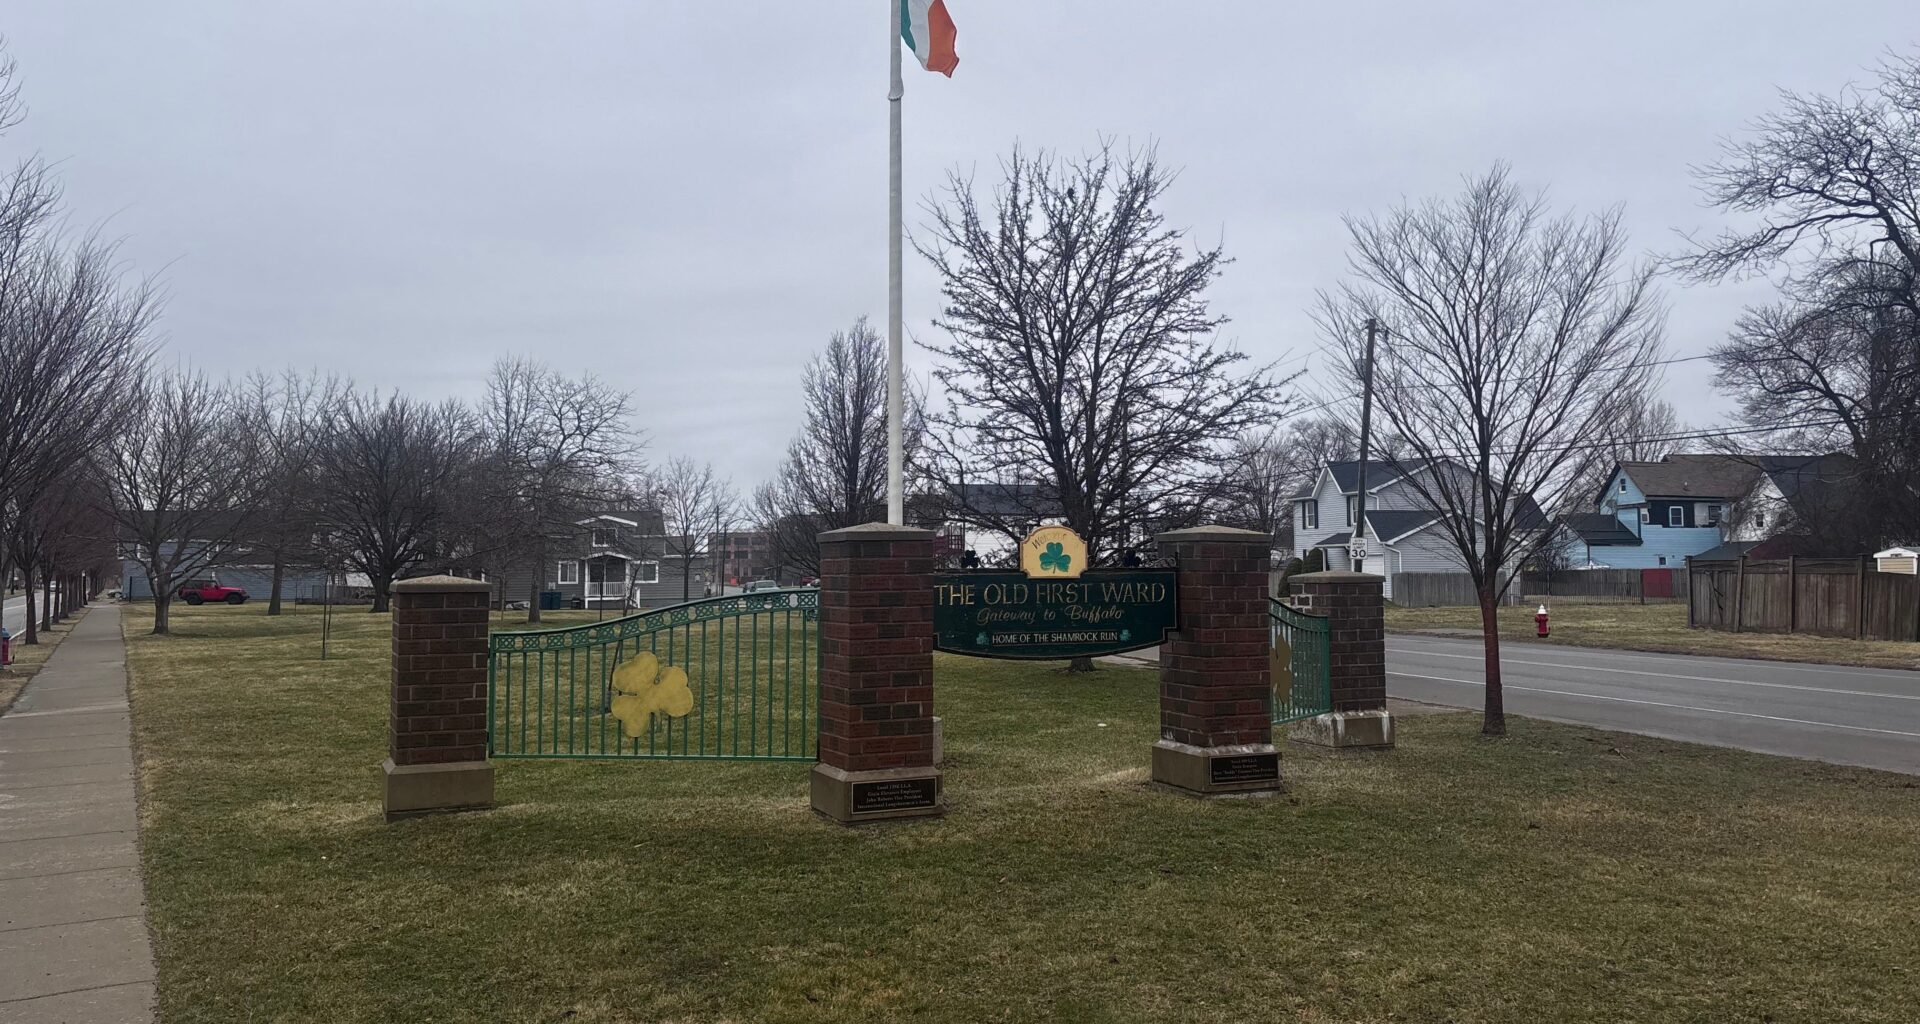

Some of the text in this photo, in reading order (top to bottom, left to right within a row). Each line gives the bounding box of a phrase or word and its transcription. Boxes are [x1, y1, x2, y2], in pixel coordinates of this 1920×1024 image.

[1352, 550, 1366, 558] 30
[933, 581, 1165, 606] THE OLD FIRST WARD
[976, 605, 1124, 626] Gateway to Buffalo
[992, 631, 1118, 644] HOME OF THE SHAMROCK RUN
